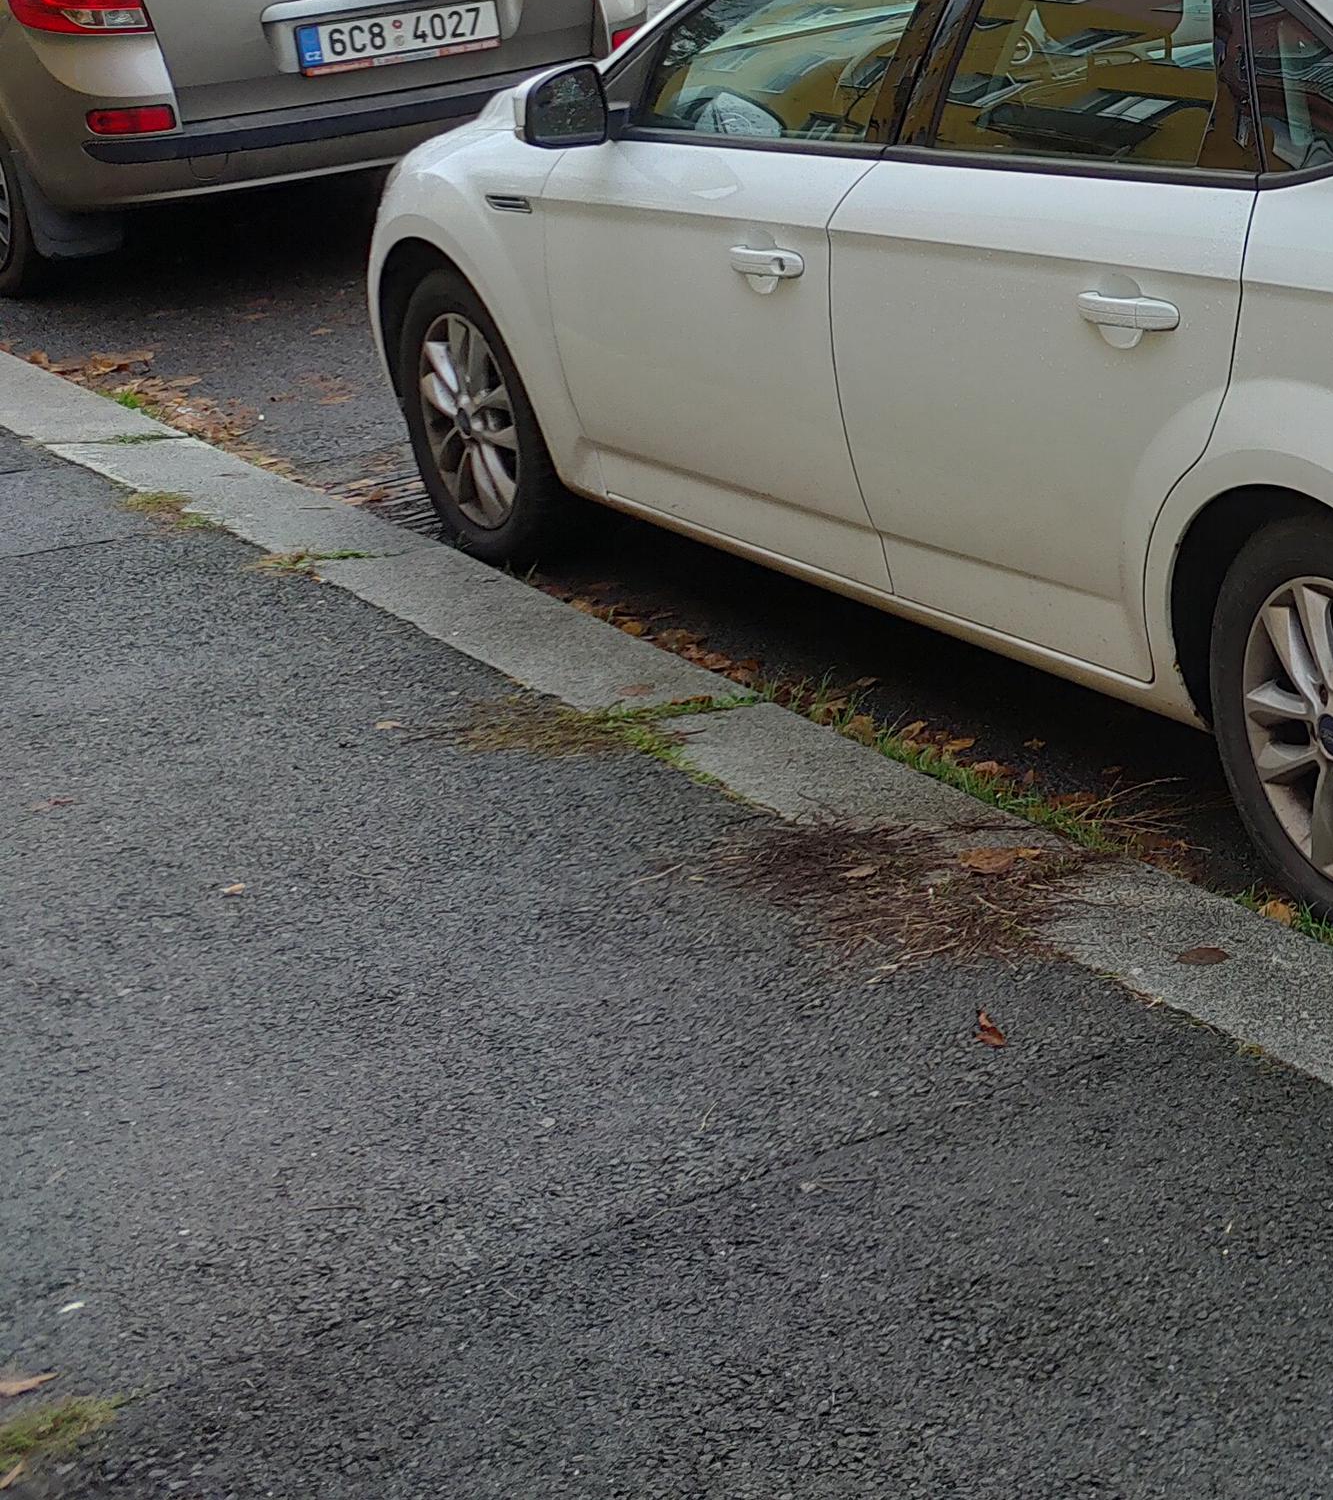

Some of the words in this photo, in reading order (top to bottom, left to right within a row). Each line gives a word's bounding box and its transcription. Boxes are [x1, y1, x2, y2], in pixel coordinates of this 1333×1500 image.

[304, 50, 322, 62] CZ
[328, 21, 387, 57] 6C8
[412, 7, 482, 44] 4027
